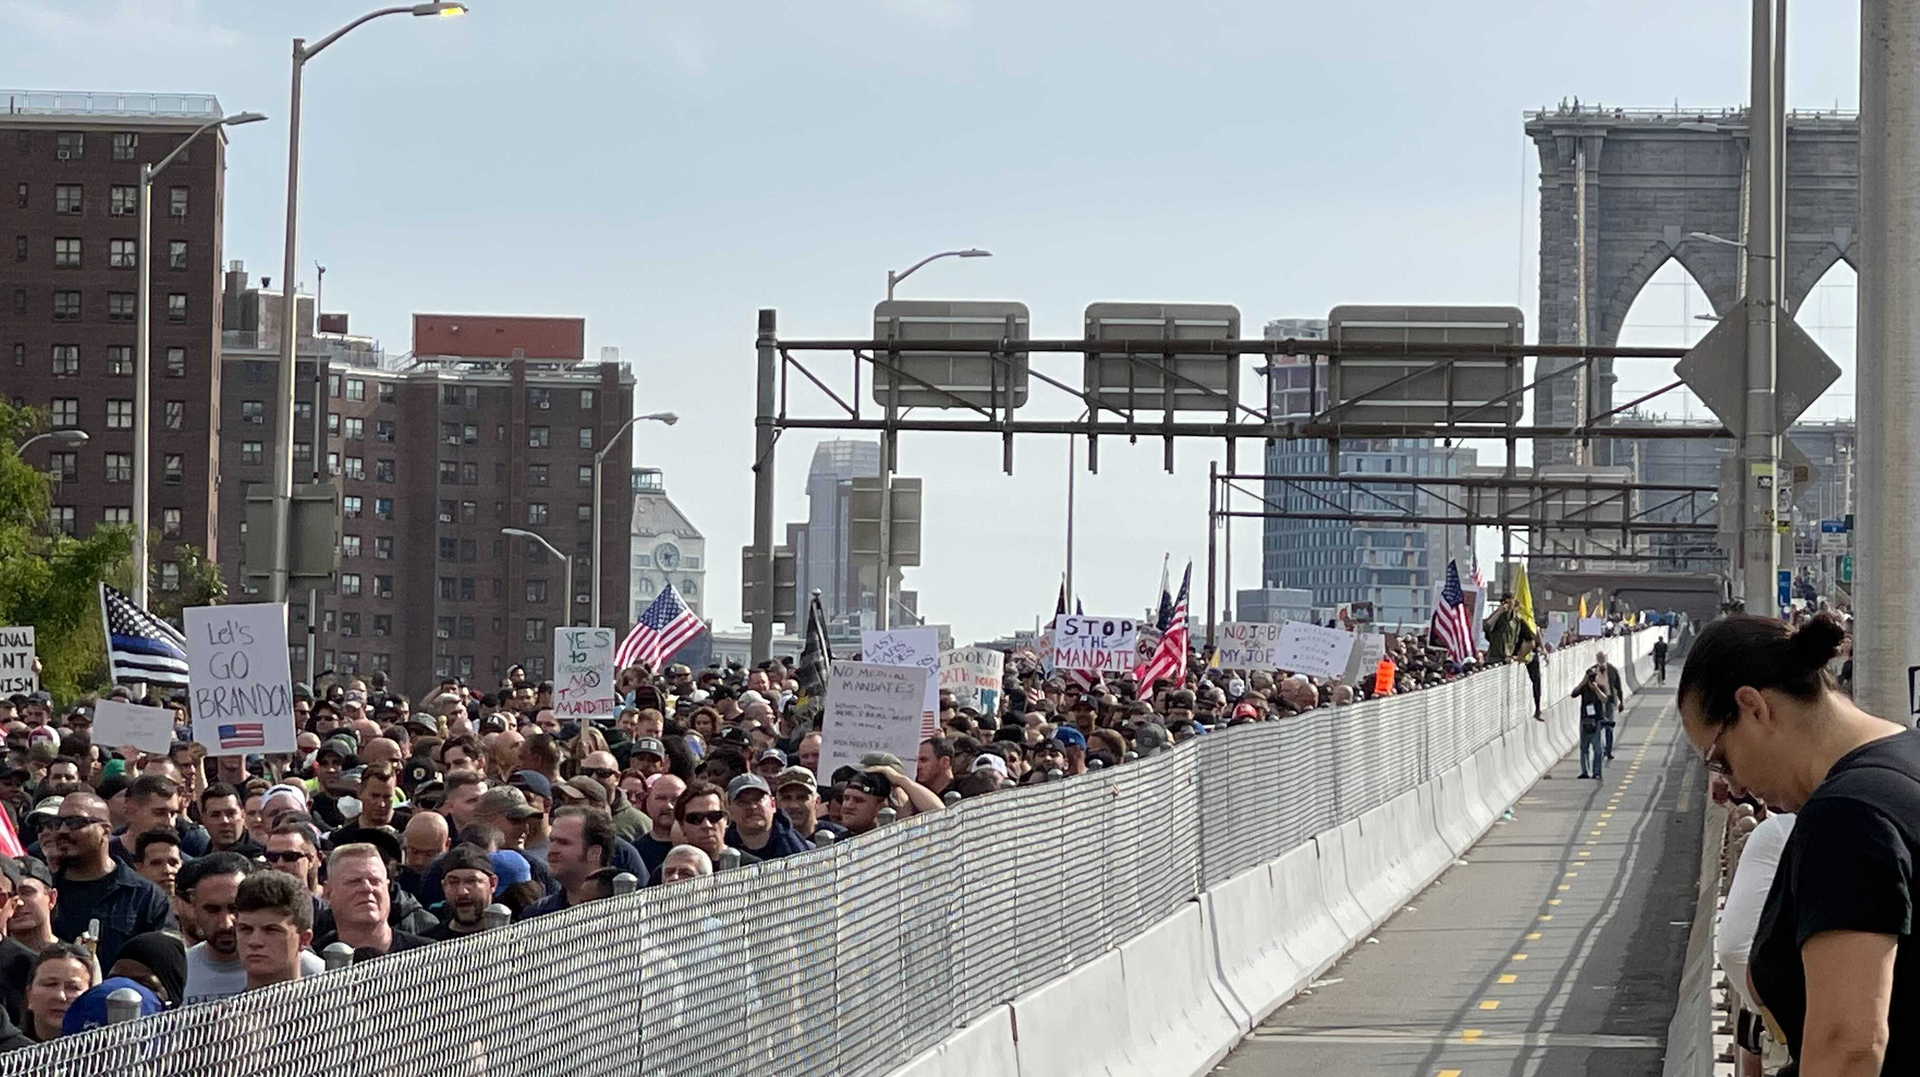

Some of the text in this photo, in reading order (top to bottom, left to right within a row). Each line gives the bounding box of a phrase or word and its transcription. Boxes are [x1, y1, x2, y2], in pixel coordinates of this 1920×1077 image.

[207, 620, 254, 645] Let's
[1064, 618, 1133, 637] STOP
[565, 631, 610, 650] YES
[1078, 635, 1109, 649] THE
[0, 652, 28, 669] NT
[948, 651, 985, 666] TOOK
[1055, 648, 1134, 670] MANDATE
[1220, 648, 1241, 663] MY
[209, 651, 249, 680] GO
[833, 665, 853, 677] NO
[842, 681, 915, 694] MANDATES
[196, 681, 292, 719] BRANDON
